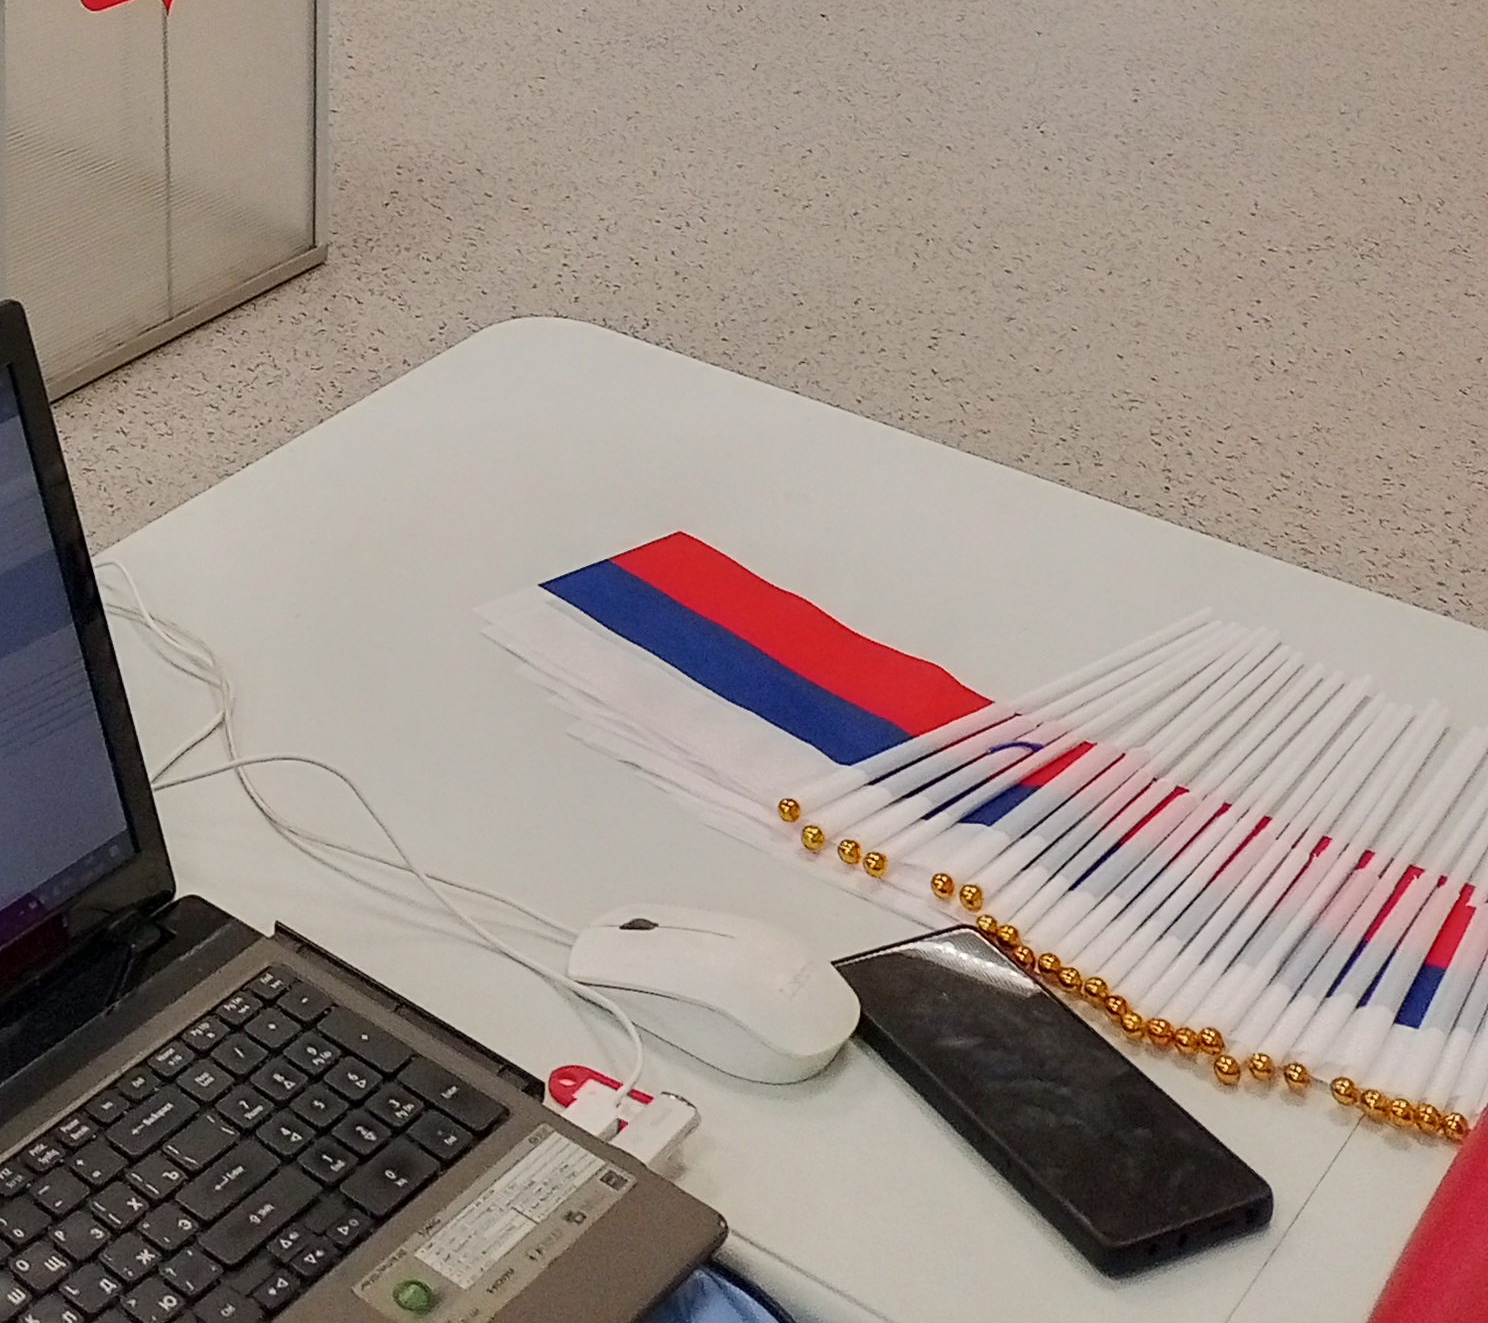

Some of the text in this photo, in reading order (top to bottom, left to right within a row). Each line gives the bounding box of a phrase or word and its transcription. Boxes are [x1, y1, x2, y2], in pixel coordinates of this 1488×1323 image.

[177, 1219, 193, 1230] Э
[44, 1256, 67, 1272] Щ
[136, 1249, 156, 1265] Ж
[99, 1278, 117, 1294] Д
[7, 1288, 26, 1304] Ш
[158, 1295, 177, 1311] Ю
